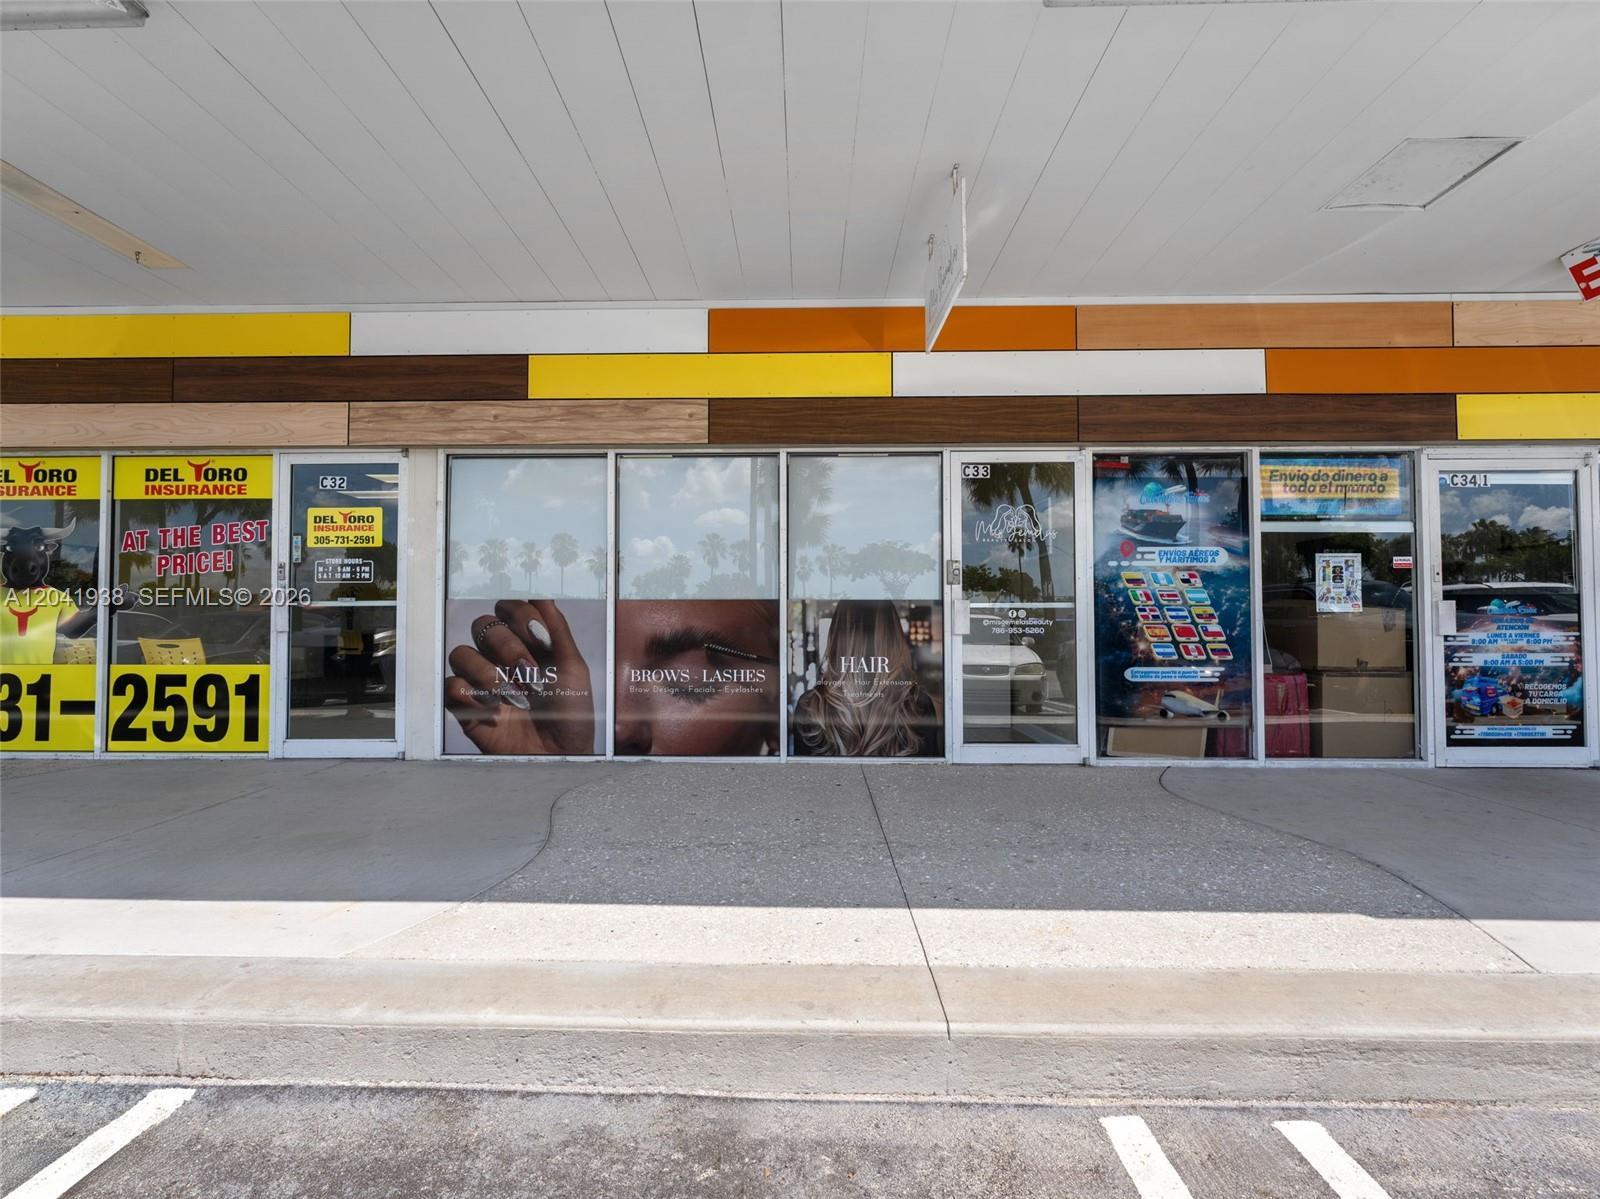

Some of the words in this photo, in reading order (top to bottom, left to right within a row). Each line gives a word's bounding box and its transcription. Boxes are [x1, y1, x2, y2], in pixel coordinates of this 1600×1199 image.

[18, 461, 77, 483] TORO
[145, 468, 184, 482] DEL
[187, 460, 247, 482] TORO
[963, 466, 989, 477] C33
[1312, 470, 1329, 482] de
[1332, 470, 1378, 482] dinero
[1380, 473, 1388, 482] a
[145, 484, 247, 495] INSURANCE
[320, 477, 346, 489] C32
[1283, 481, 1317, 494] todo
[1319, 481, 1332, 494] el
[314, 515, 337, 524] DEL
[339, 511, 374, 524] TORO
[122, 530, 149, 553] AT
[159, 526, 202, 550] THE
[211, 520, 269, 545] BEST
[314, 536, 374, 544] 305-731-2591
[156, 550, 234, 576] PRICE!
[840, 656, 890, 673] HAIR
[494, 667, 558, 684] NAILS
[630, 669, 690, 683] BROWS
[703, 669, 766, 683] LASHES
[873, 678, 912, 686] Extensions
[460, 688, 489, 696] Russian
[492, 688, 528, 696] Manicure
[538, 688, 553, 698] Spa
[555, 688, 588, 696] Pedicure
[652, 686, 679, 695] Design
[688, 685, 715, 693] Facials
[725, 686, 763, 695] Eyelashes
[844, 690, 884, 698] Treatments
[111, 673, 260, 742] 2591
